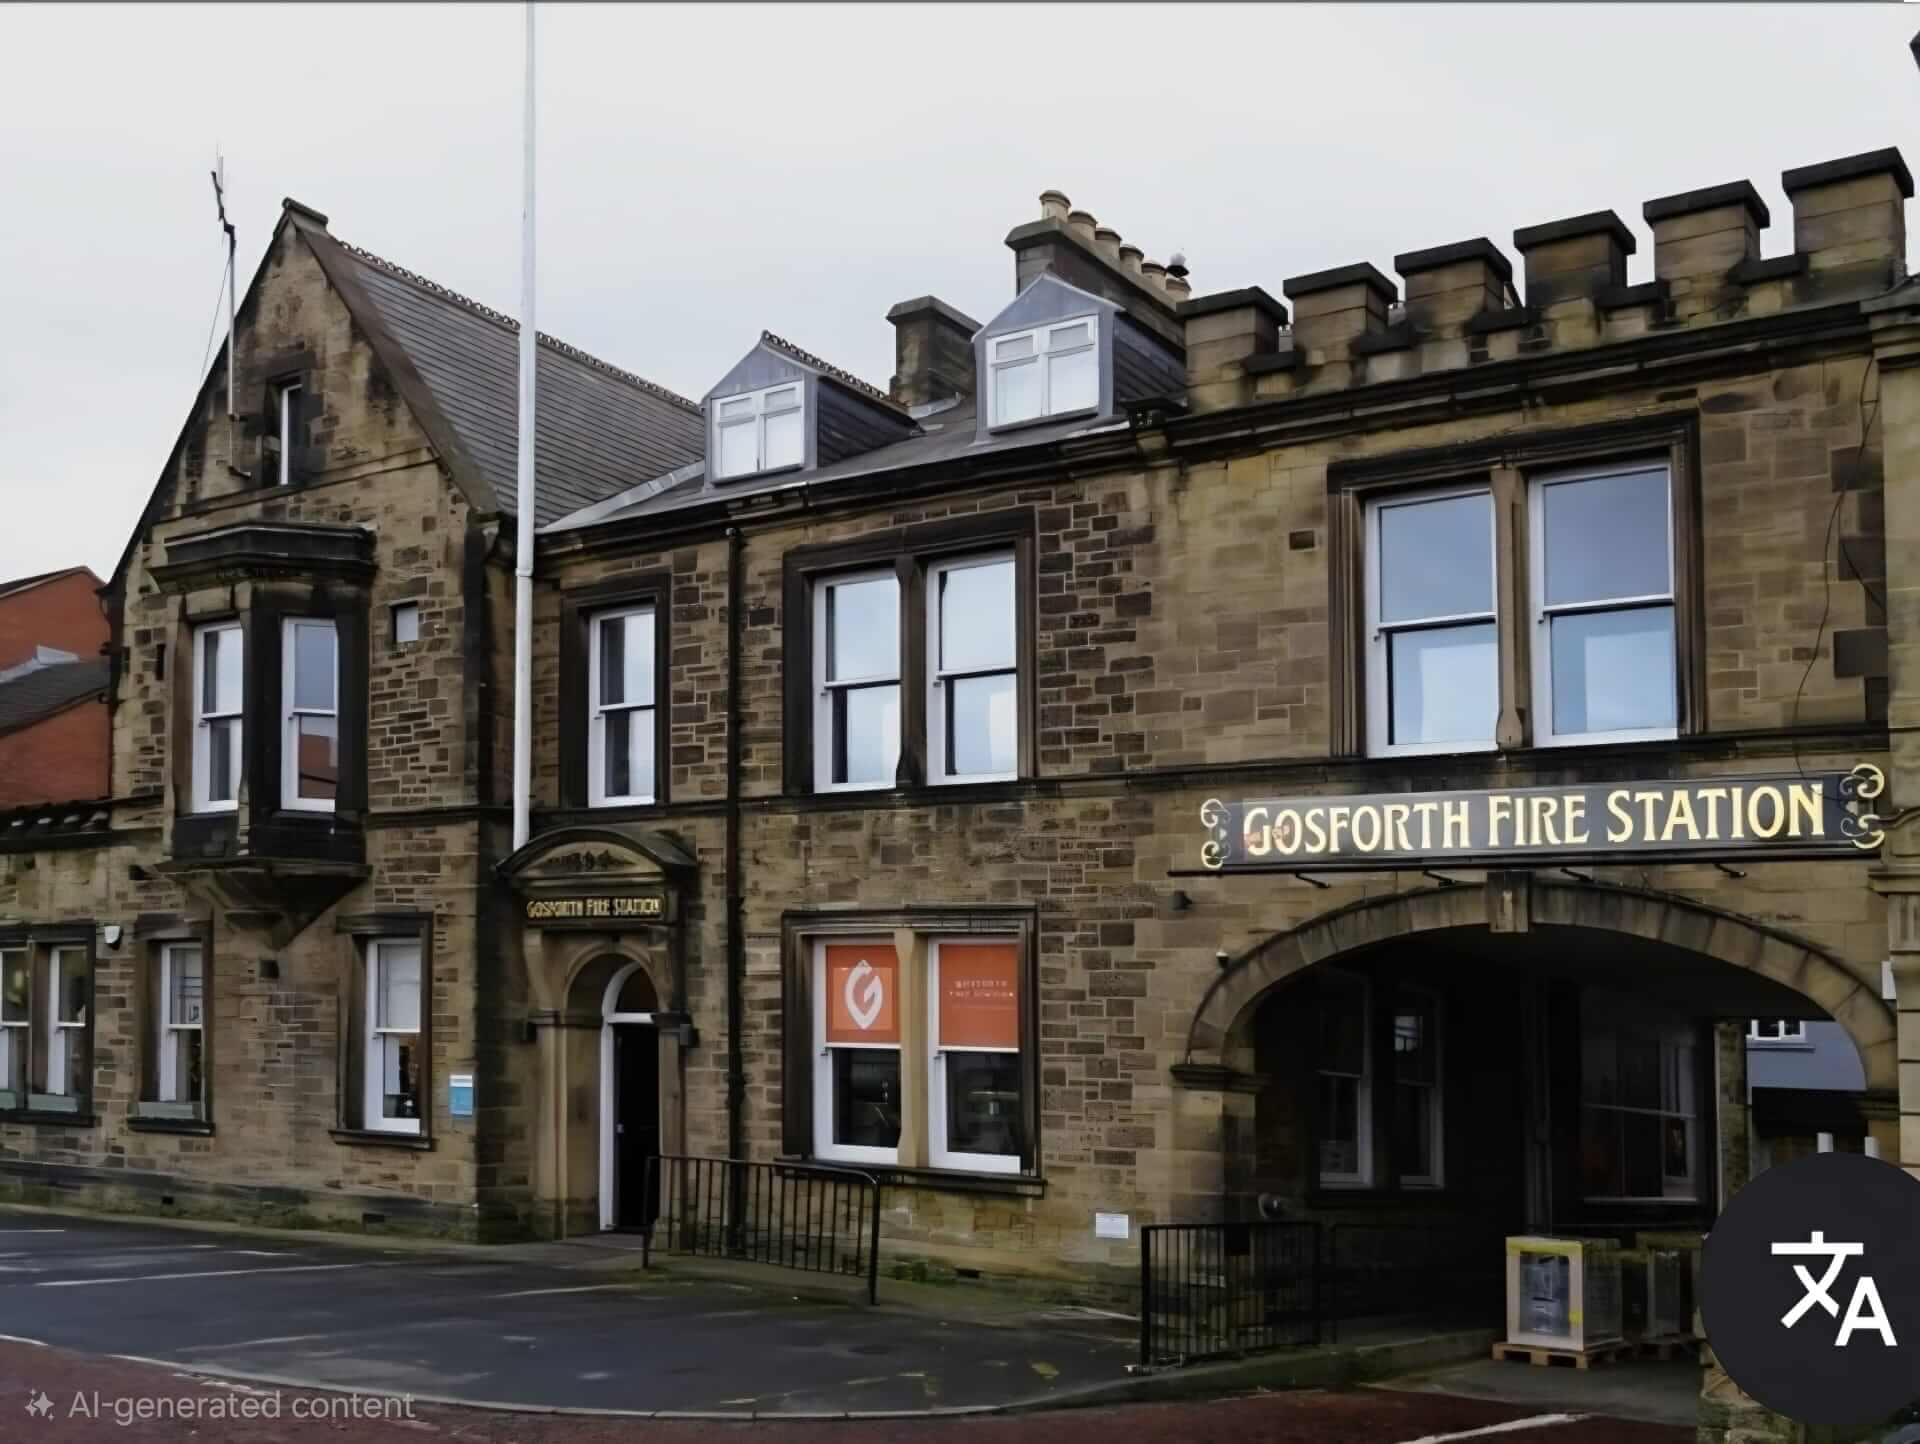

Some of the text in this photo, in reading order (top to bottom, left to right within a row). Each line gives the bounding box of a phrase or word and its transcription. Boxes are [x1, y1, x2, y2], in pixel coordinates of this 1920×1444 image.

[1243, 783, 1826, 857] GOSFORTH FIRE STATION
